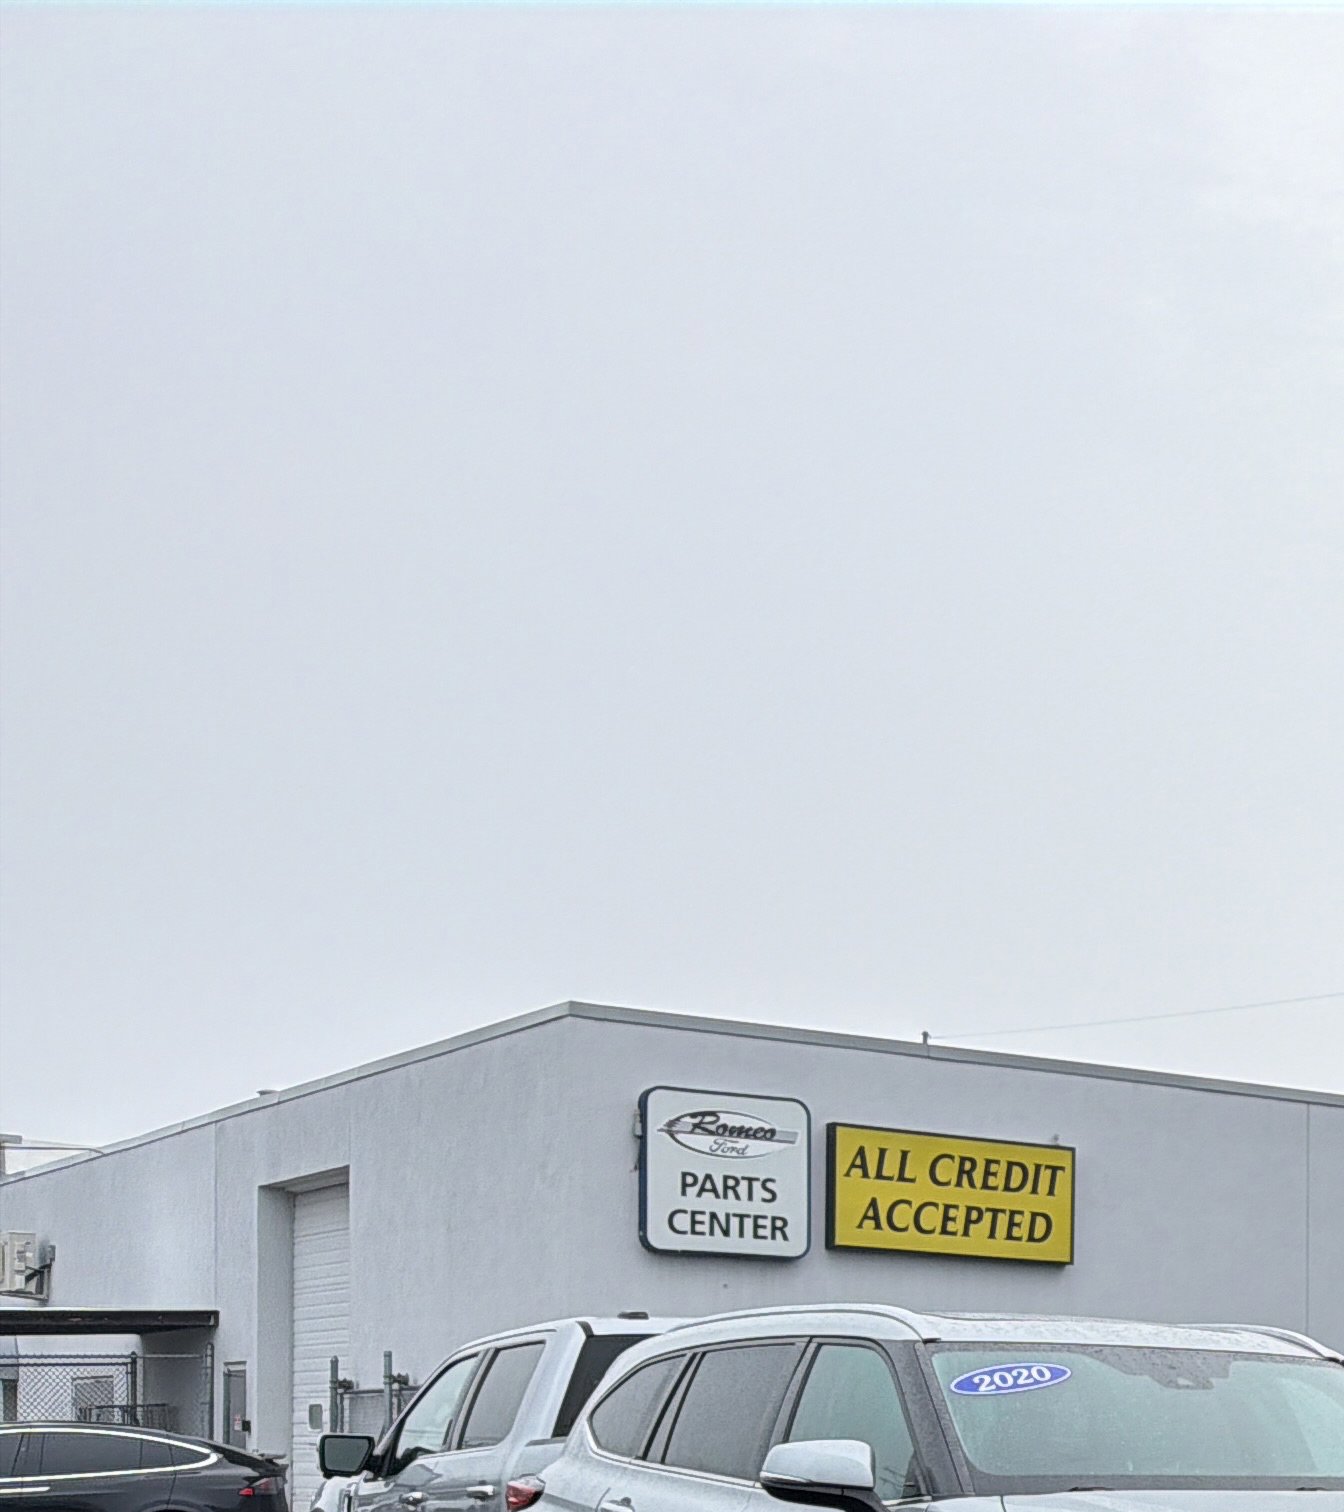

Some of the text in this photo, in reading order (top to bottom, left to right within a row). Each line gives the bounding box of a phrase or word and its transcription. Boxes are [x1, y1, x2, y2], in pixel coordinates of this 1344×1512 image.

[690, 1111, 777, 1140] Romeo
[709, 1138, 750, 1156] Ford
[681, 1171, 778, 1203] PARTS
[843, 1146, 1066, 1197] ALL CREDIT
[668, 1209, 790, 1242] CENTER
[856, 1197, 1053, 1243] ACCEPTED
[972, 1366, 1051, 1392] 2020
